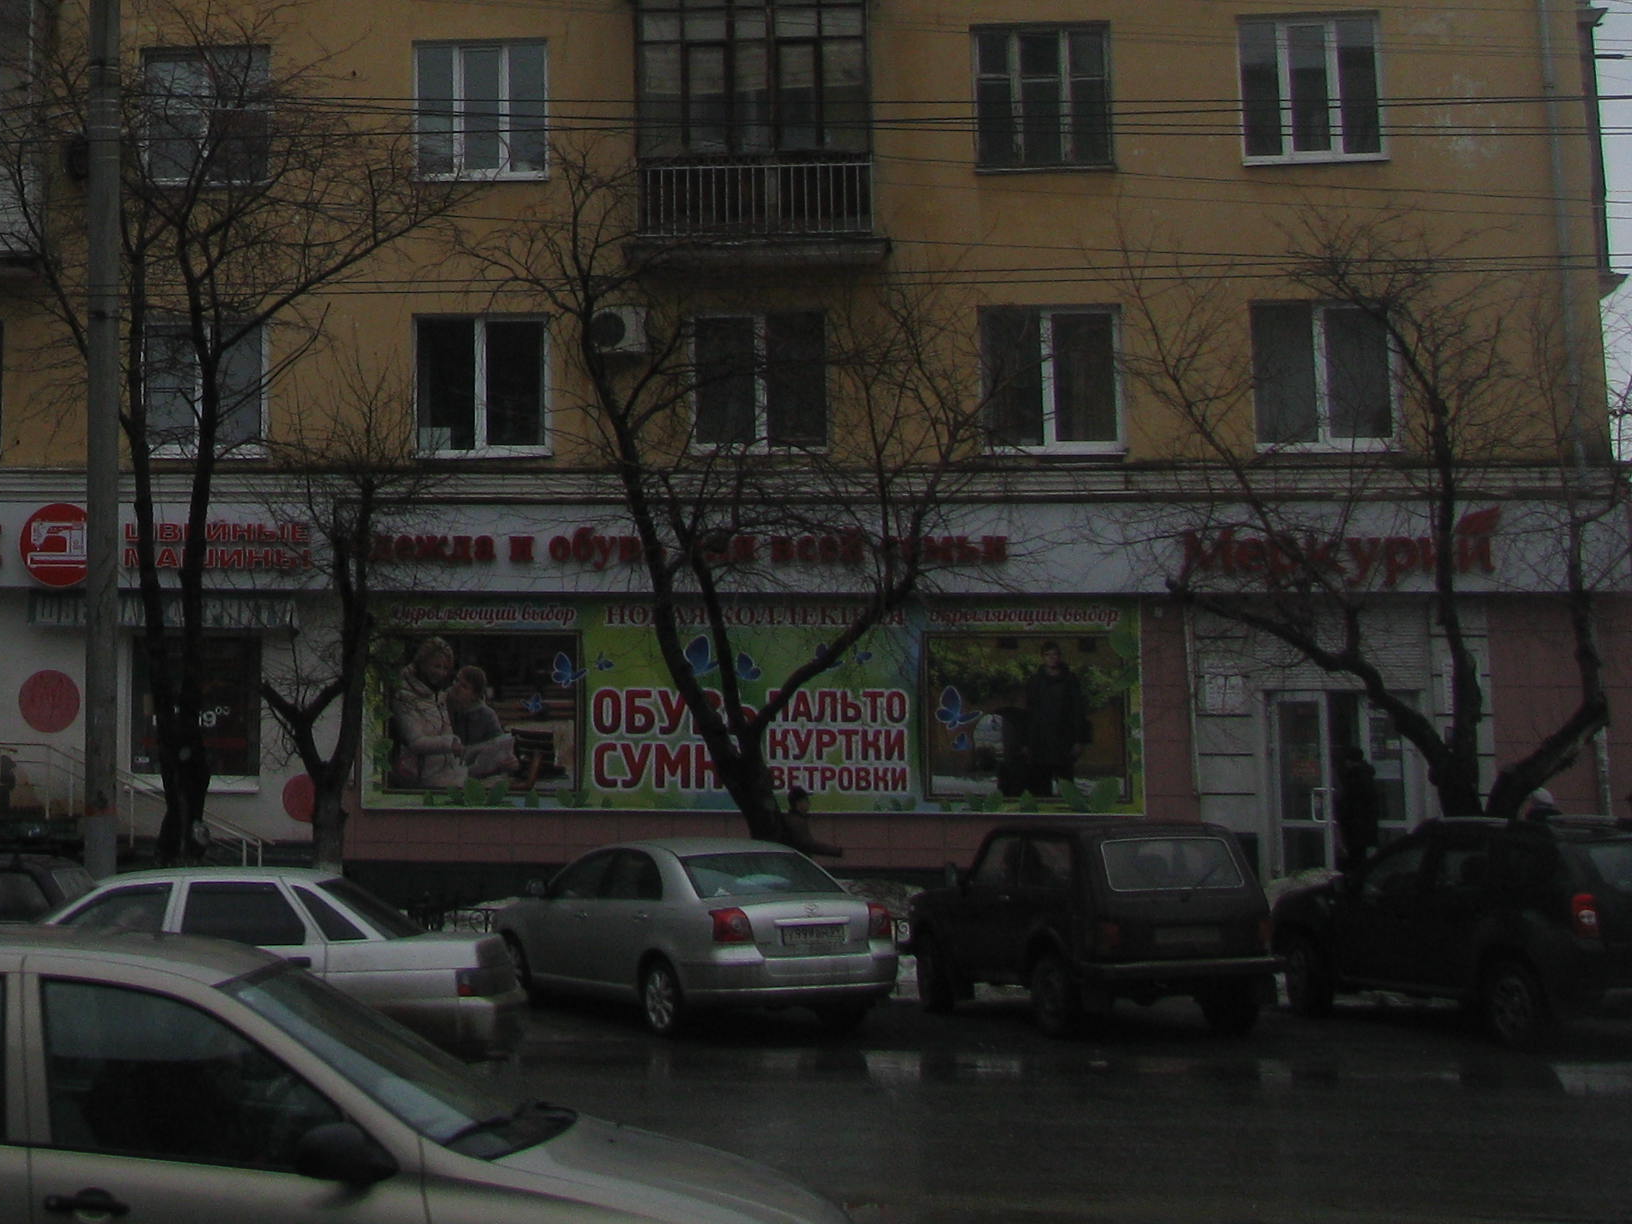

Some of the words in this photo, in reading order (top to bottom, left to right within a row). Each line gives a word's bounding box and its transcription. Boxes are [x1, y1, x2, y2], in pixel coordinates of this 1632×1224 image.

[124, 519, 310, 543] ШВЙНЫЕ
[351, 534, 497, 564] дежда
[508, 535, 535, 562] и
[548, 525, 668, 570] обув
[521, 603, 576, 625] выбор
[1062, 604, 1120, 626] выбор
[768, 689, 908, 724] ПАЛЬТО
[768, 728, 906, 761] КУРТКИ
[593, 742, 730, 789] СУМК
[770, 765, 908, 792] ВЕТРОВКИ
